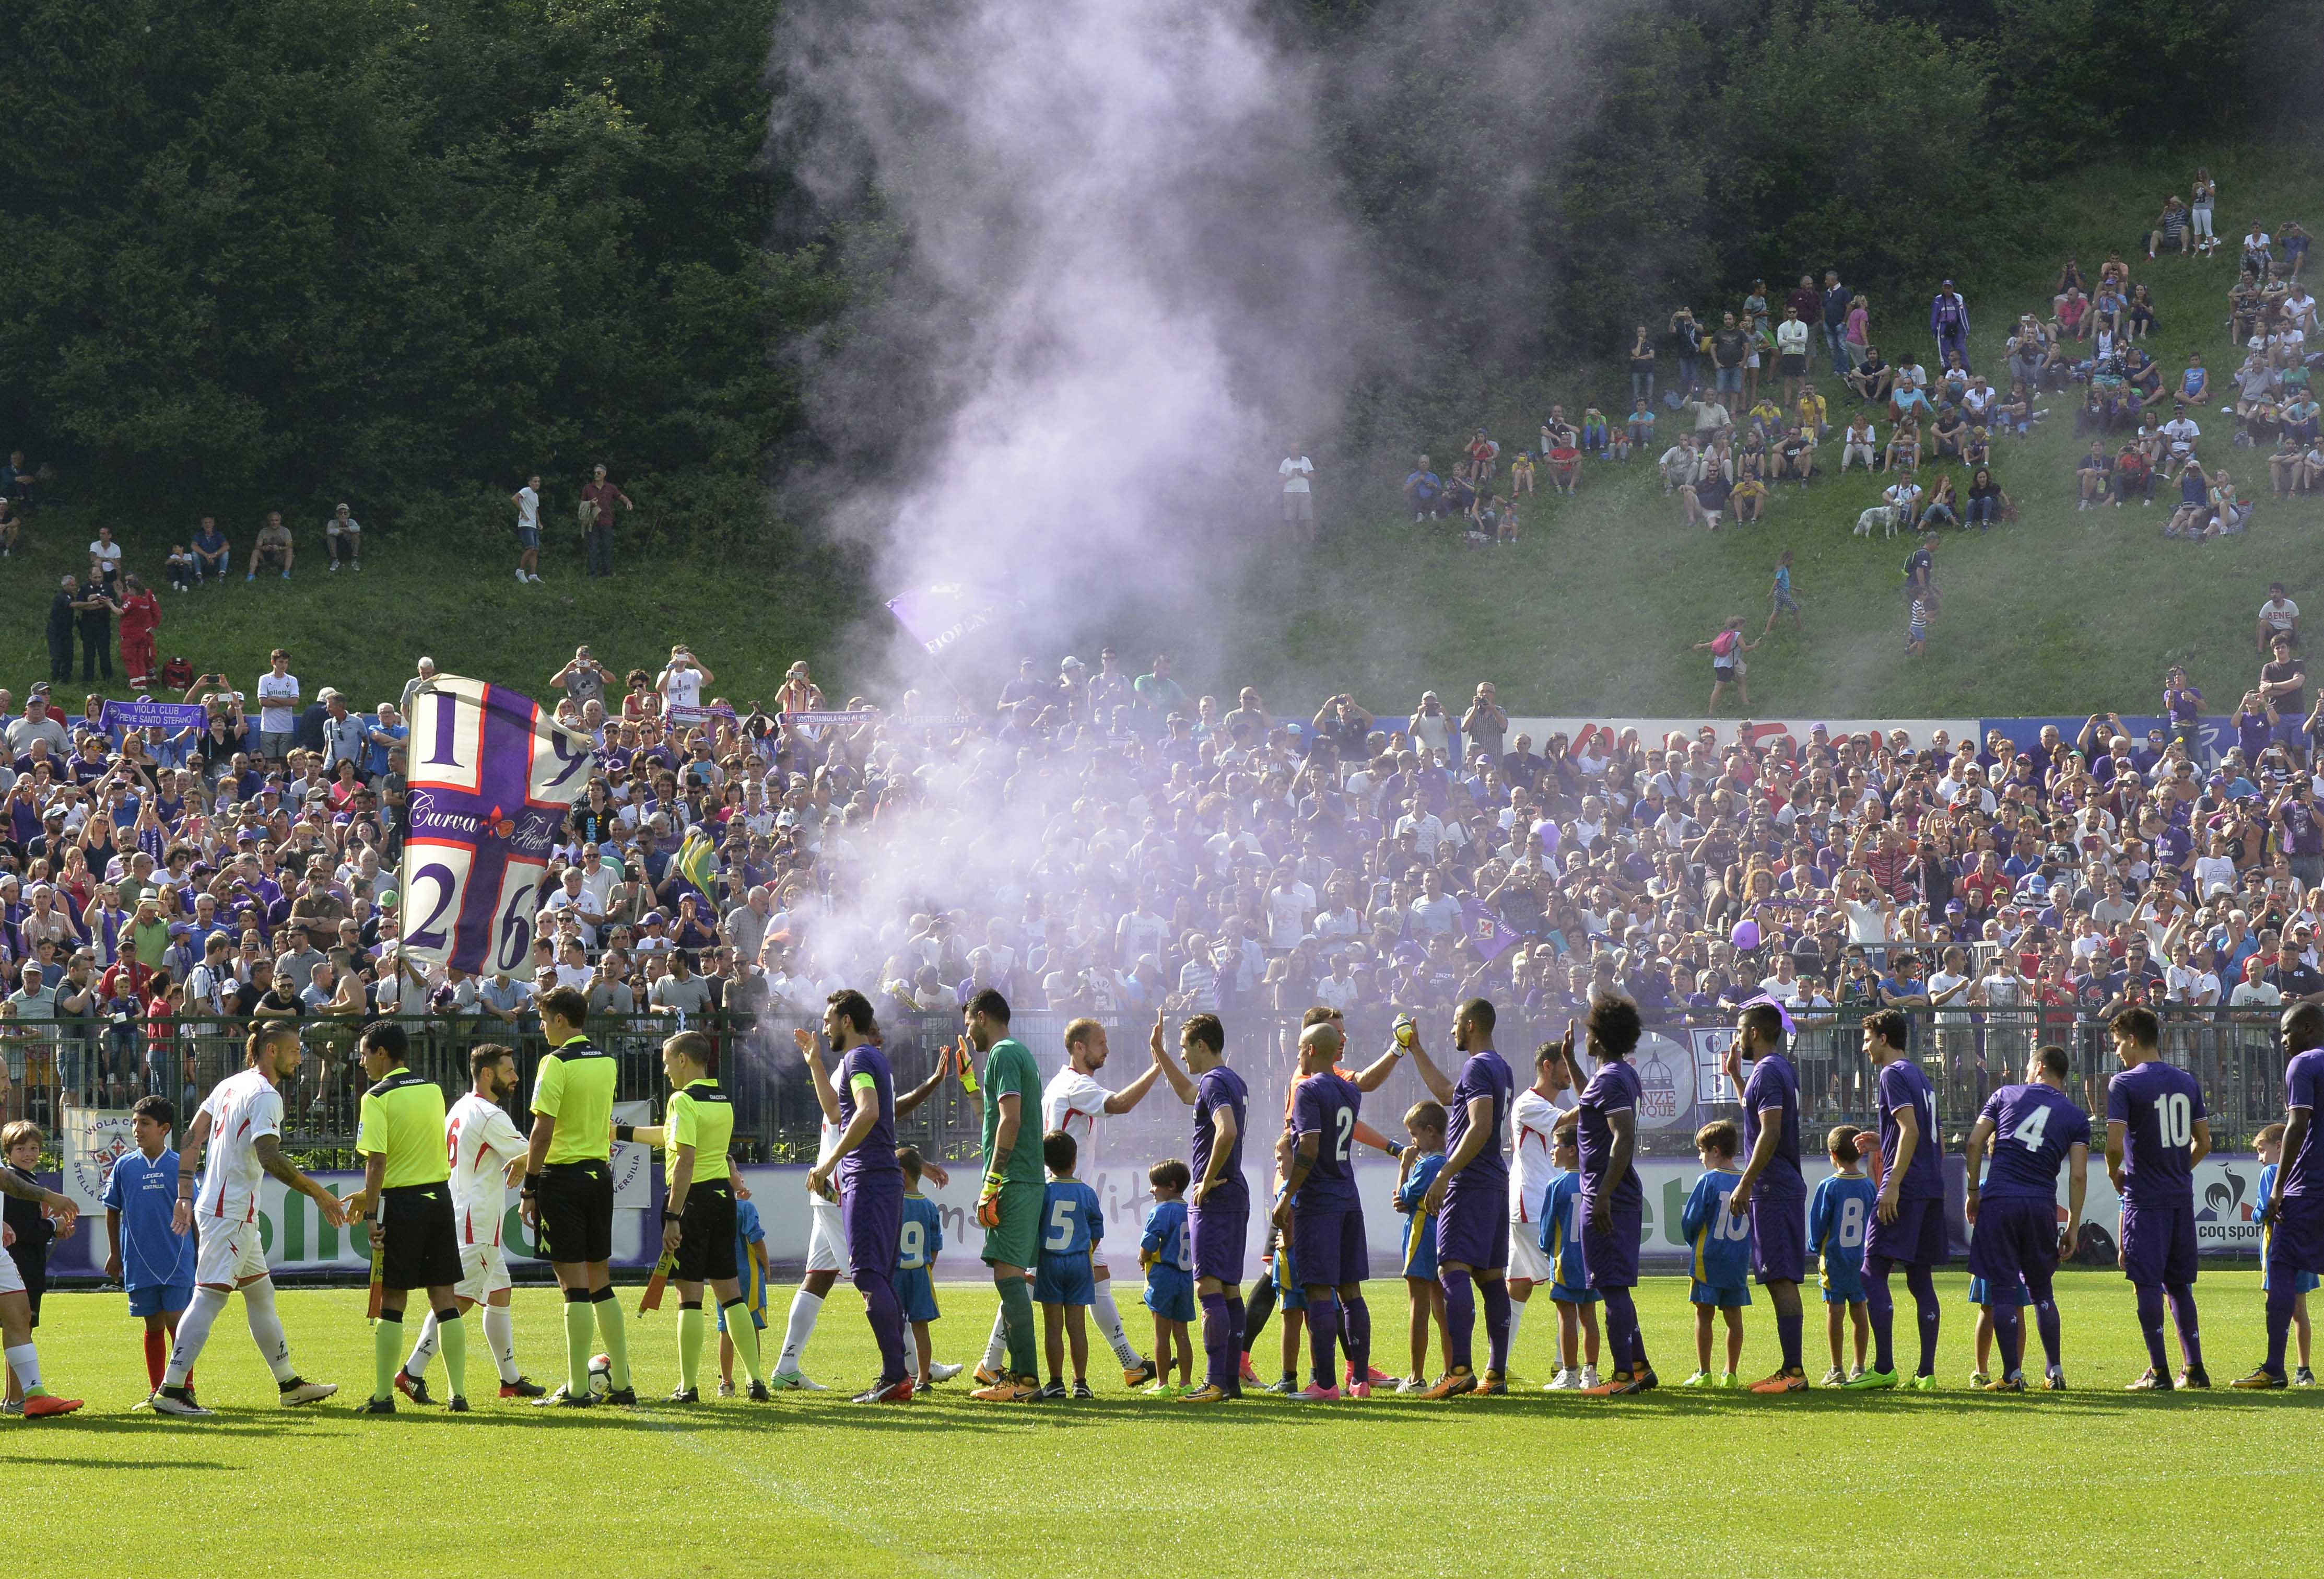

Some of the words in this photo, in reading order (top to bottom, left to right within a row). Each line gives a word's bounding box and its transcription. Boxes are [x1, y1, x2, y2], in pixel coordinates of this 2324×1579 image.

[119, 714, 137, 722] PIEVE
[139, 715, 161, 724] SANTO
[163, 715, 192, 724] STEFANO
[134, 705, 156, 715] VIOLA
[159, 706, 180, 715] CLUB
[421, 691, 464, 768] 1
[542, 730, 592, 787] 9
[405, 789, 478, 833] Curva
[403, 863, 456, 950] 2
[498, 883, 534, 971] 6
[85, 1118, 118, 1136] VIOLA
[447, 1117, 460, 1168] 6
[1336, 1106, 1353, 1161] 2
[2014, 1105, 2051, 1152] 4
[2154, 1093, 2191, 1148] 10
[74, 1162, 95, 1197] STELLA
[613, 1155, 640, 1194] VERSILIA
[1046, 1200, 1076, 1250] 5
[1713, 1191, 1750, 1241] 10
[1839, 1198, 1864, 1247] 8
[2199, 1225, 2226, 1241] coq
[900, 1221, 925, 1269] 9
[417, 1347, 432, 1357] ZEUS
